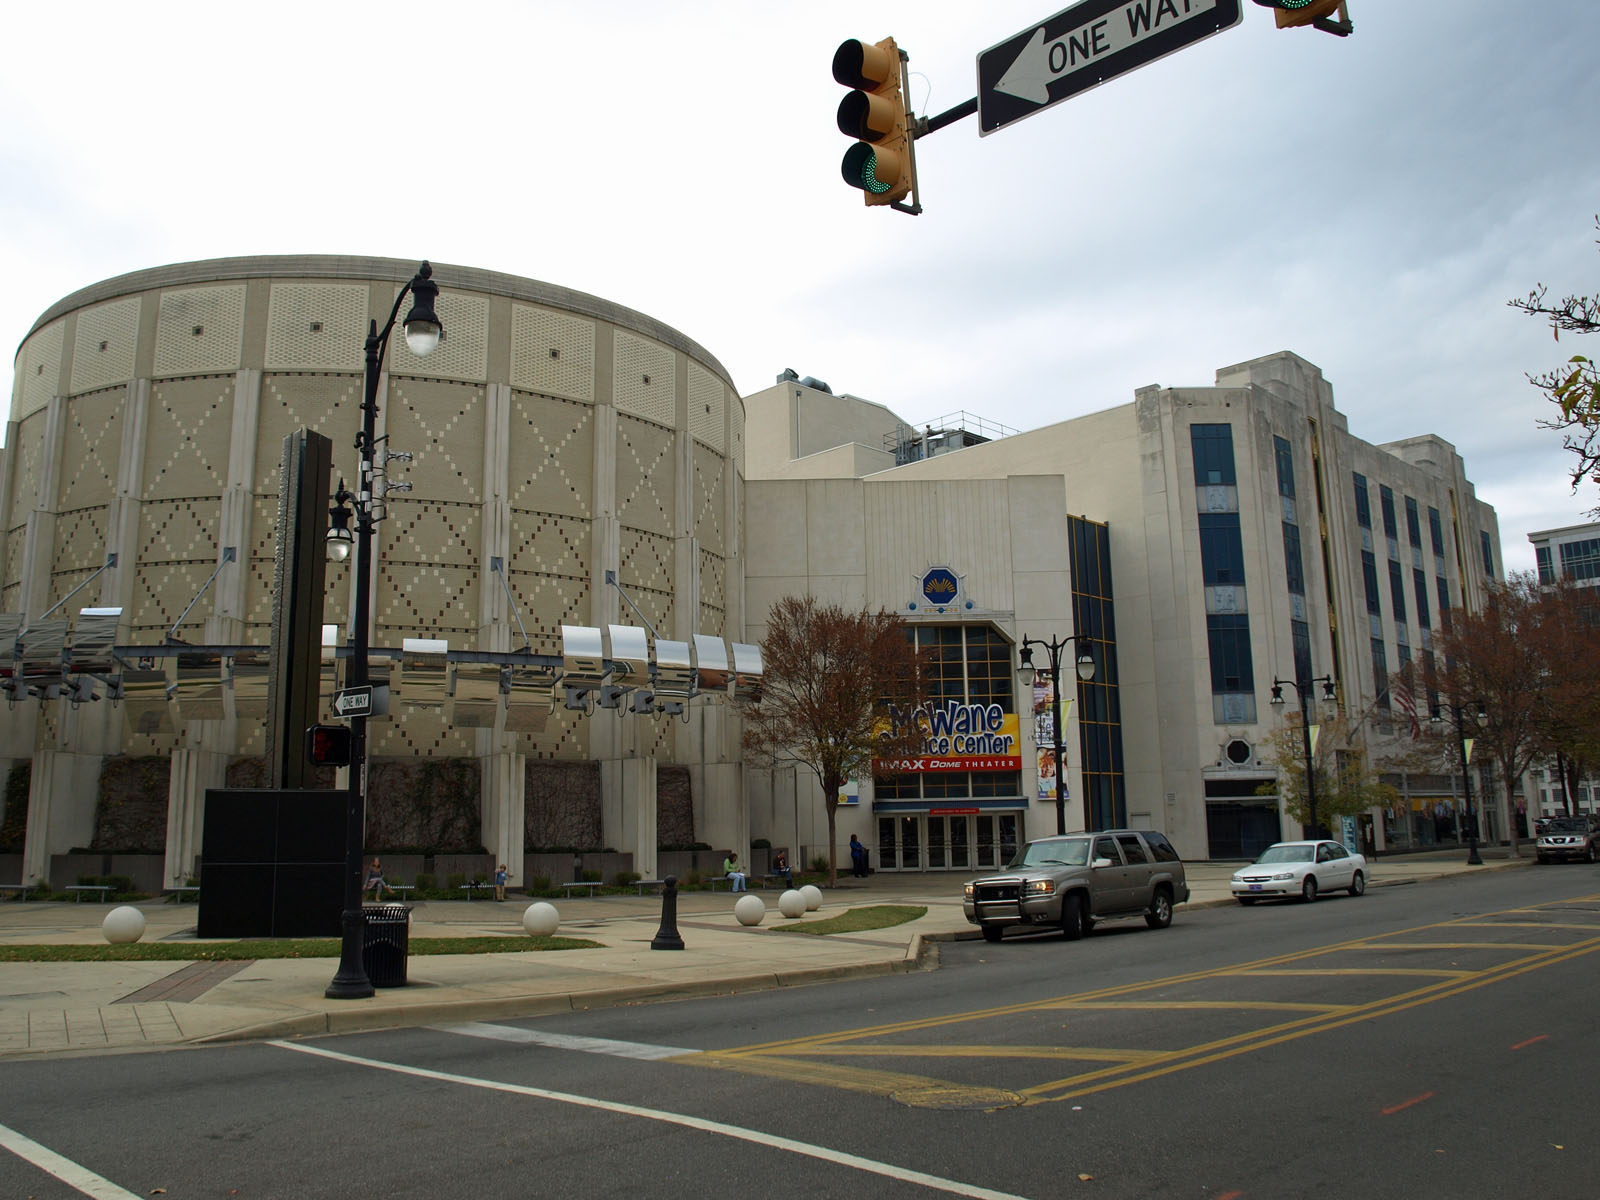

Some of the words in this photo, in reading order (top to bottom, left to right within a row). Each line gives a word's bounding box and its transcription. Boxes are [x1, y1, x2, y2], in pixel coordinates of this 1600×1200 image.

[1048, 19, 1111, 74] ONE
[343, 696, 354, 708] ONE
[355, 695, 367, 707] WAY
[888, 700, 1004, 737] McWane
[880, 760, 925, 770] IMAX
